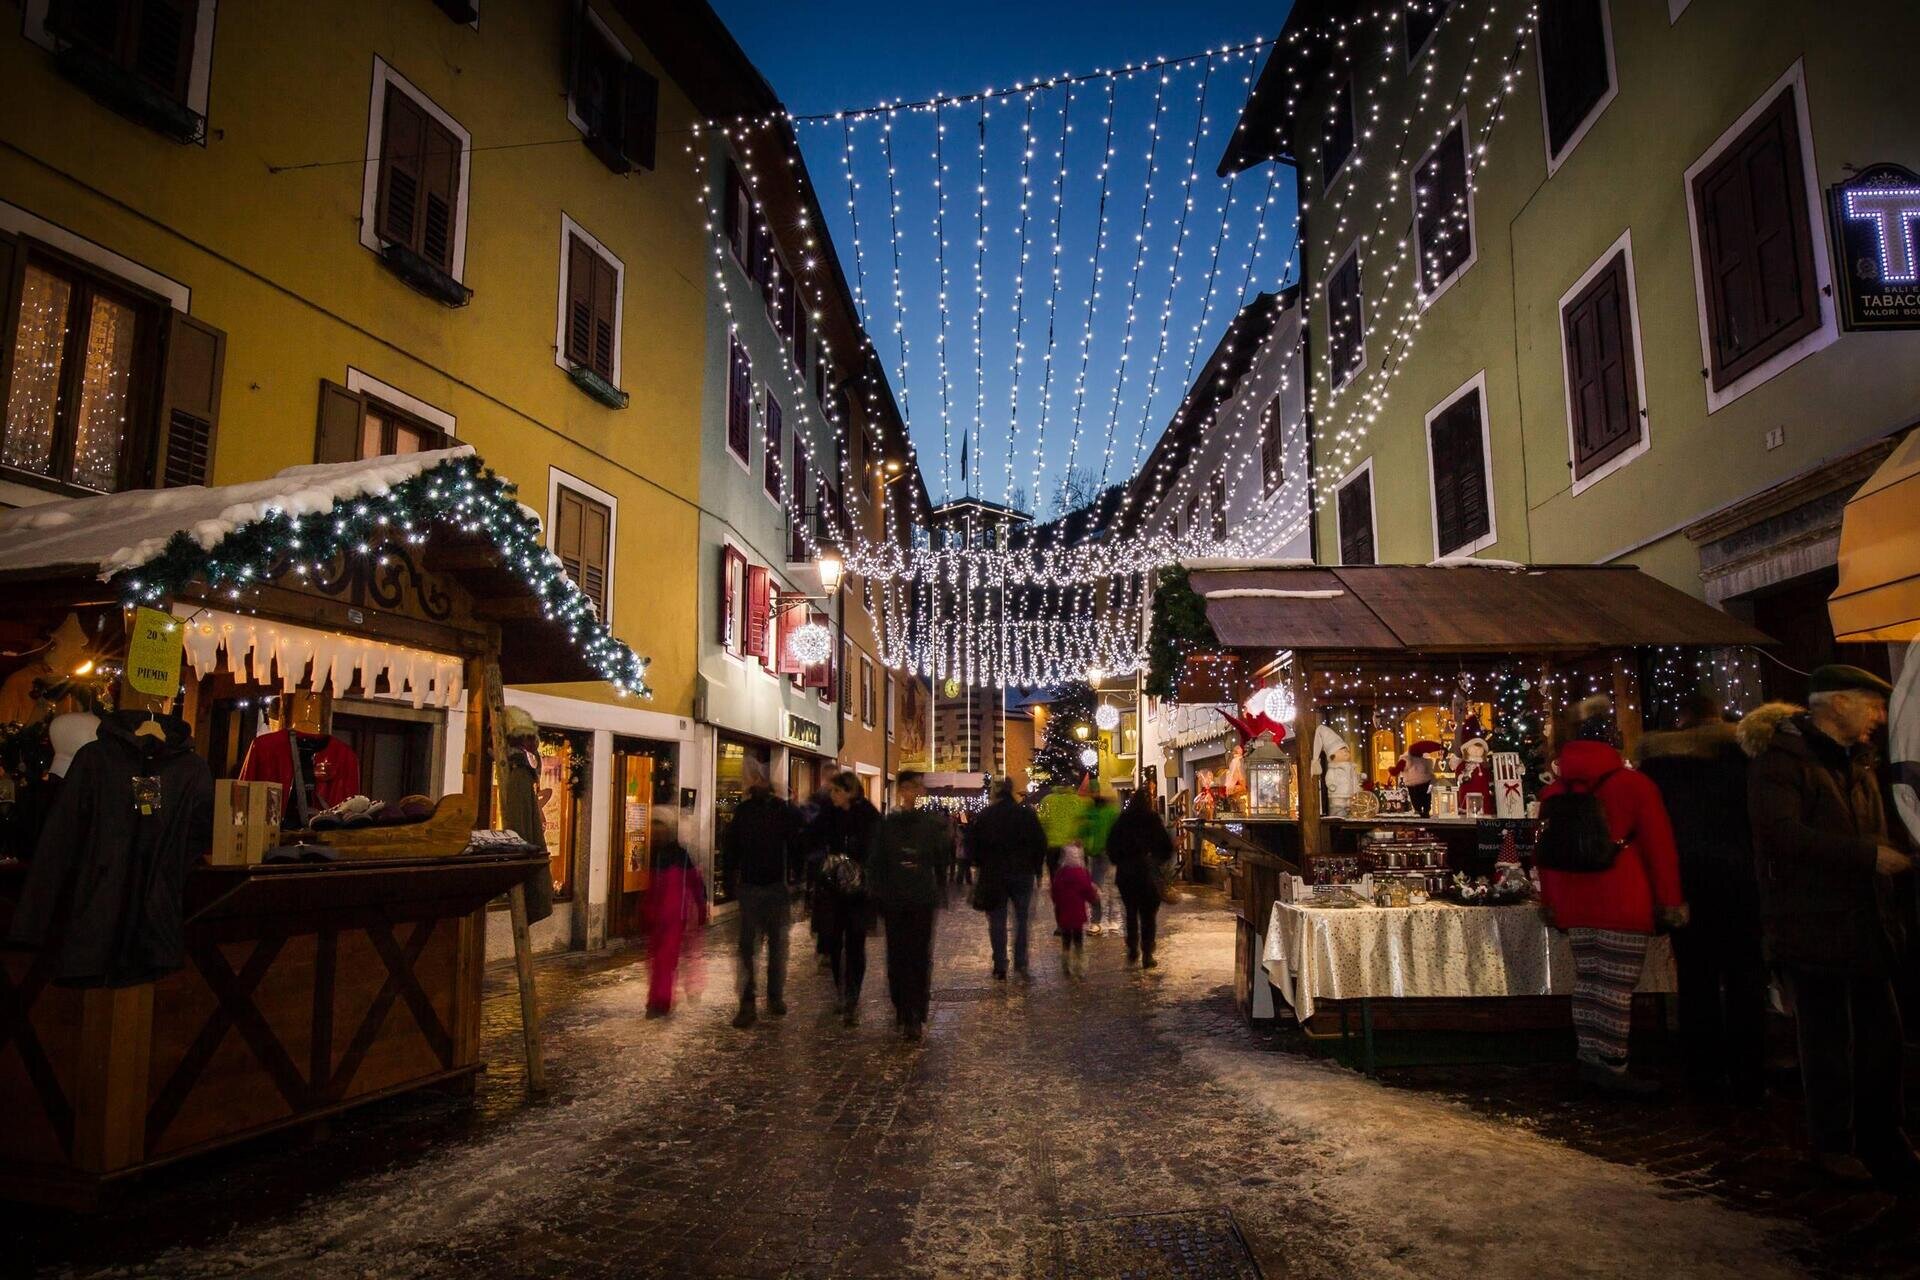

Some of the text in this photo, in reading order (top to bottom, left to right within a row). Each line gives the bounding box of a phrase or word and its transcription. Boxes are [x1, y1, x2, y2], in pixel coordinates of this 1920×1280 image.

[1847, 190, 1920, 280] T
[1863, 308, 1899, 316] VALORI
[147, 630, 157, 640] 20
